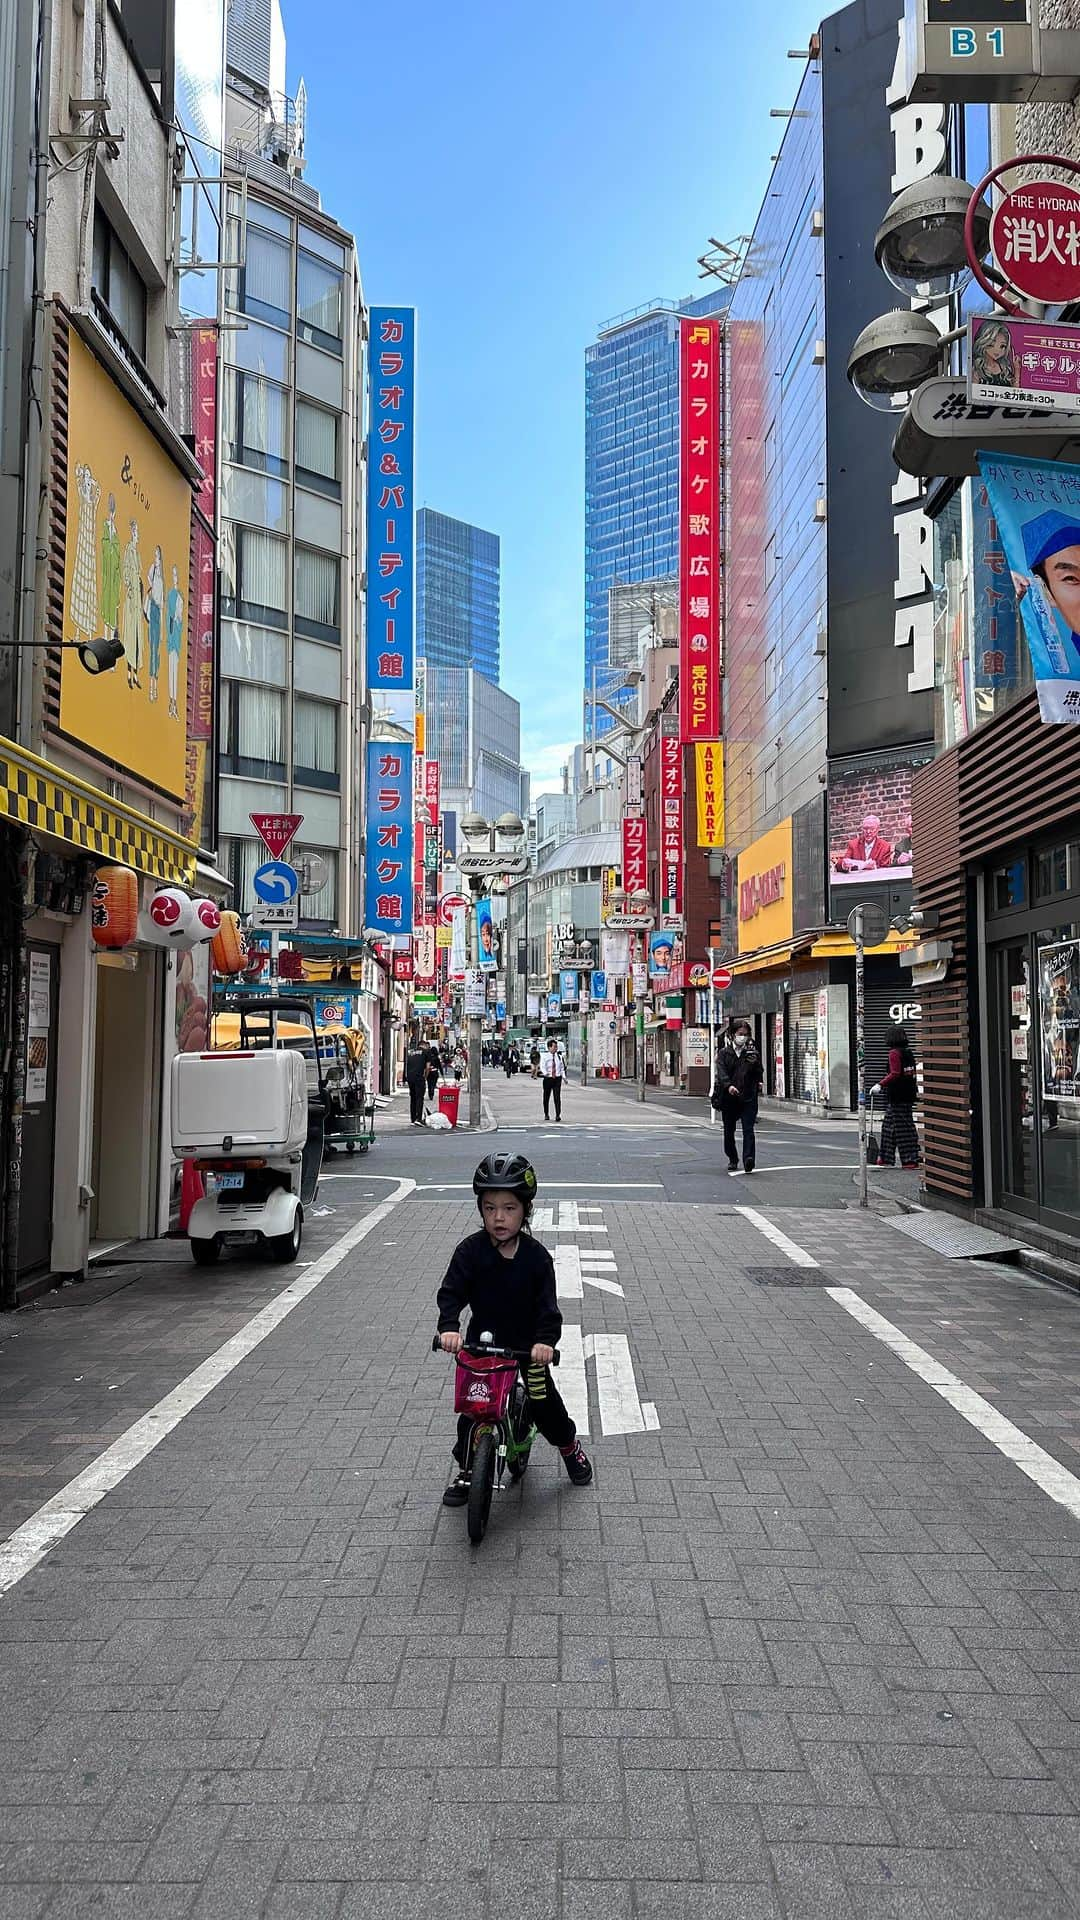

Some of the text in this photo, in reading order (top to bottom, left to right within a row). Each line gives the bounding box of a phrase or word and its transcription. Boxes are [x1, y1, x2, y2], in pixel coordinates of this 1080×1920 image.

[1010, 195, 1035, 209] FIRE
[121, 454, 133, 488] &
[378, 319, 404, 678] カラオケ&パーティー館
[690, 359, 711, 728] カラオケ歌広場 受付5F
[665, 737, 680, 794] カラオケ
[261, 819, 293, 830] 止まれ
[267, 831, 289, 840] STOP
[376, 754, 403, 919] カラオケ館
[665, 815, 680, 863] 歌広場
[461, 857, 523, 867] 渋谷センター街
[626, 819, 644, 895] カラオケ
[256, 908, 294, 917] 一方通行
[553, 923, 574, 940] ABC
[396, 961, 411, 973] B1
